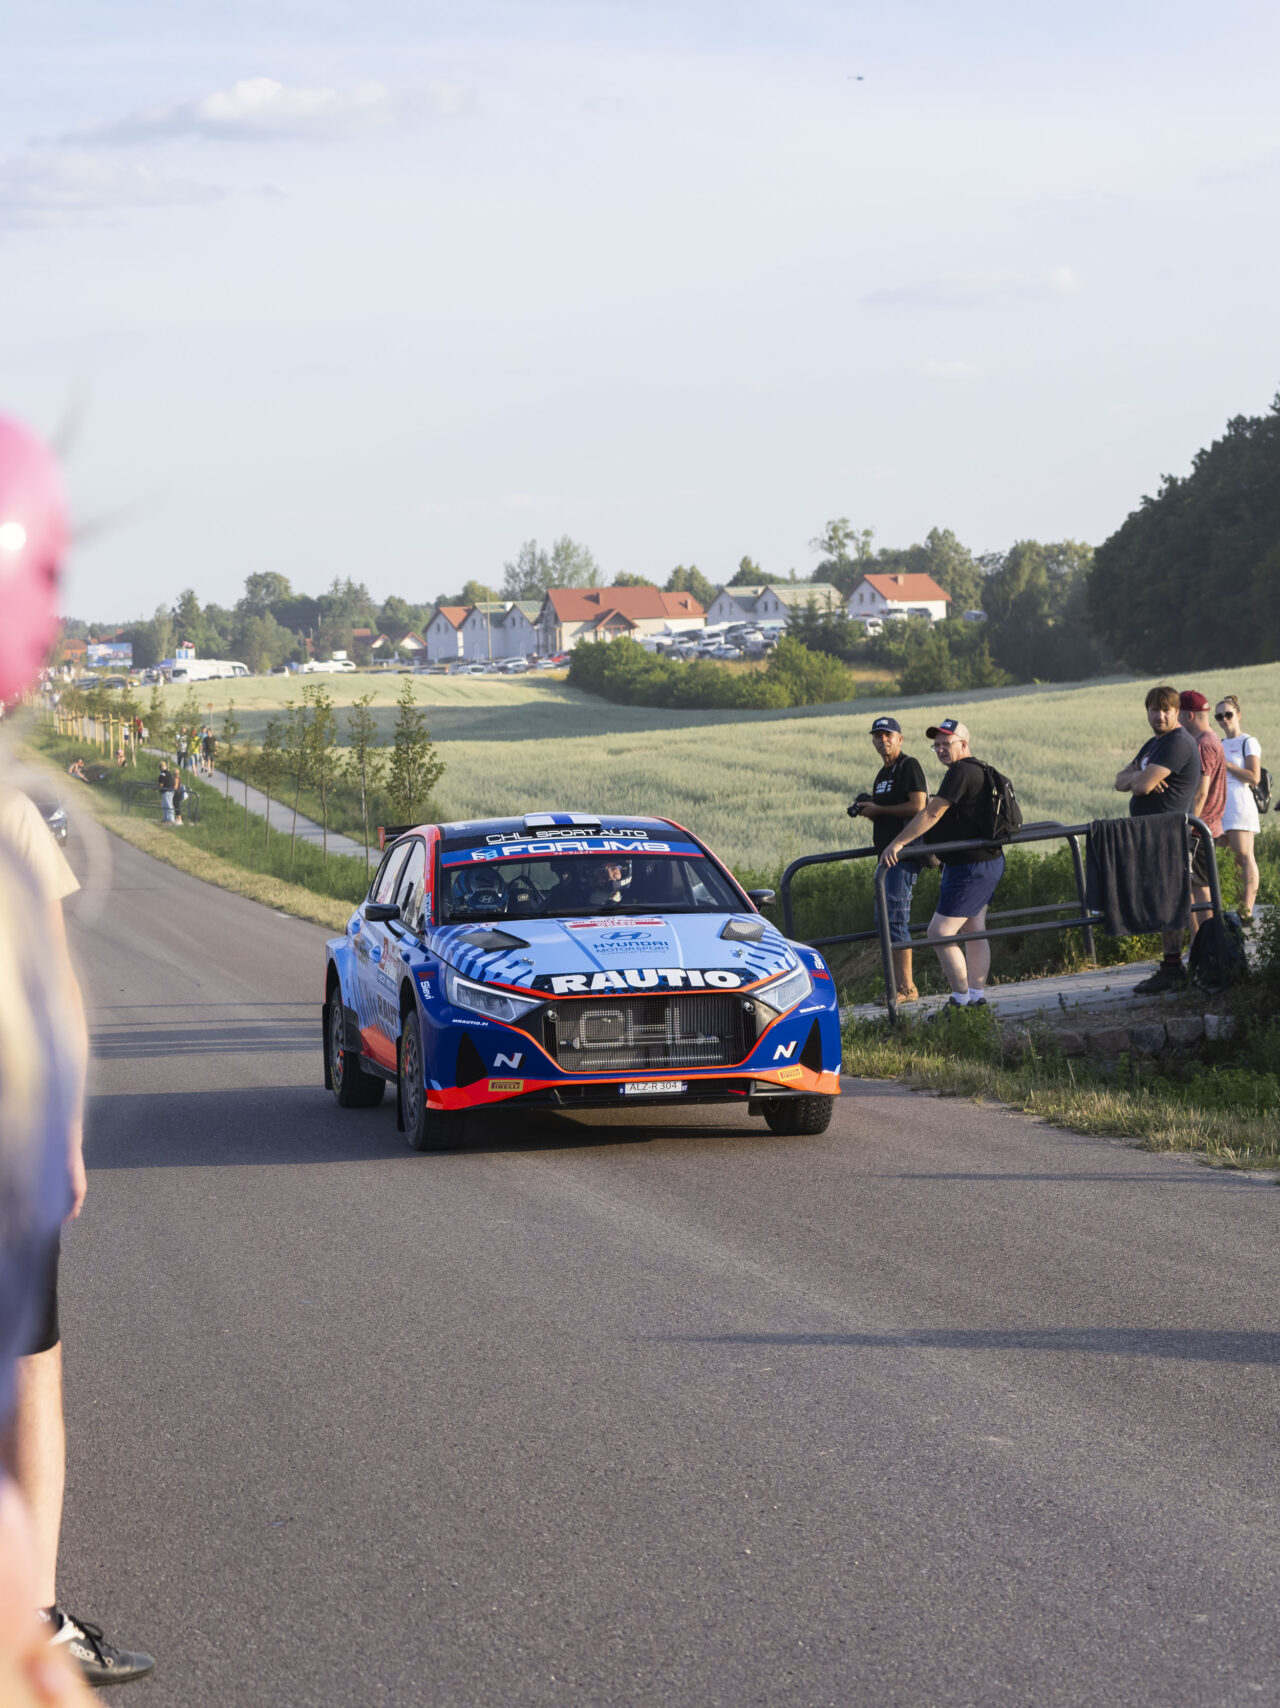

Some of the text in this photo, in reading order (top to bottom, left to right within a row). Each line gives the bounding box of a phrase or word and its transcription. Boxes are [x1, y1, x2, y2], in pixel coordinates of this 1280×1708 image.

[485, 829, 648, 843] CHL SPORT AUTO
[501, 840, 671, 857] FORUM8
[593, 941, 669, 949] HYUNDAI
[550, 968, 742, 994] RAUTIO
[420, 980, 435, 1000] Sievi
[780, 1068, 802, 1079] PIRELLI
[490, 1081, 521, 1091] PIRELLI
[629, 1082, 658, 1091] ALZ-R
[660, 1081, 677, 1090] 304
